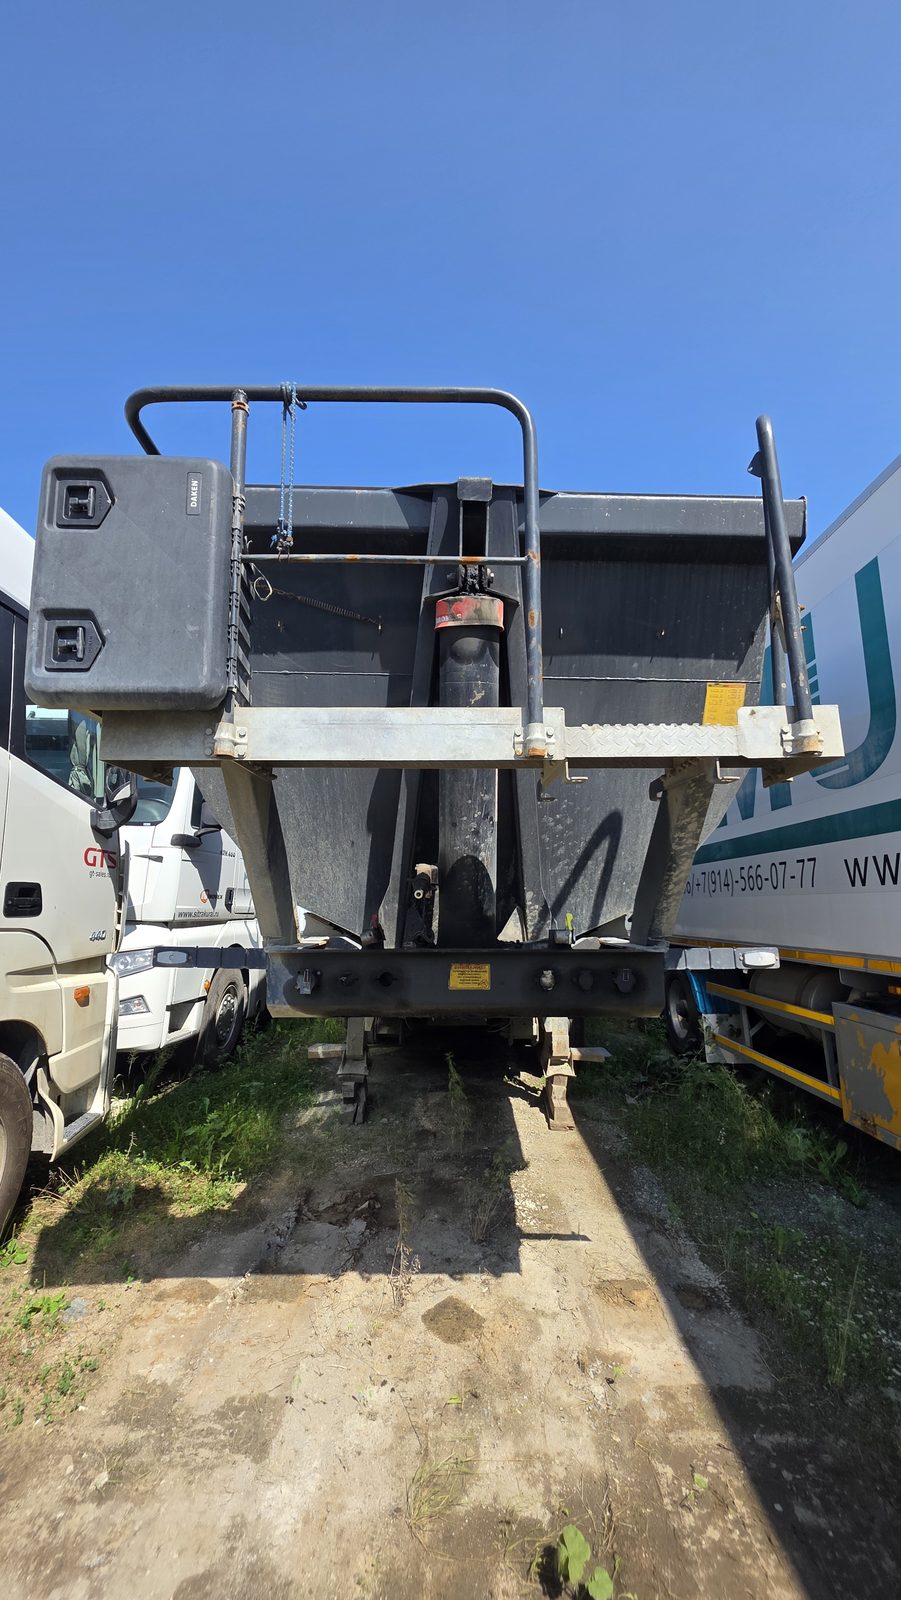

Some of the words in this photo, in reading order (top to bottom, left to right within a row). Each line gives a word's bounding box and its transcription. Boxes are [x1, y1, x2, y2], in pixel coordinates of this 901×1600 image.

[190, 479, 199, 508] DAKEN
[83, 847, 117, 869] GTS
[683, 857, 817, 898] o/+7(914)-566-07-77
